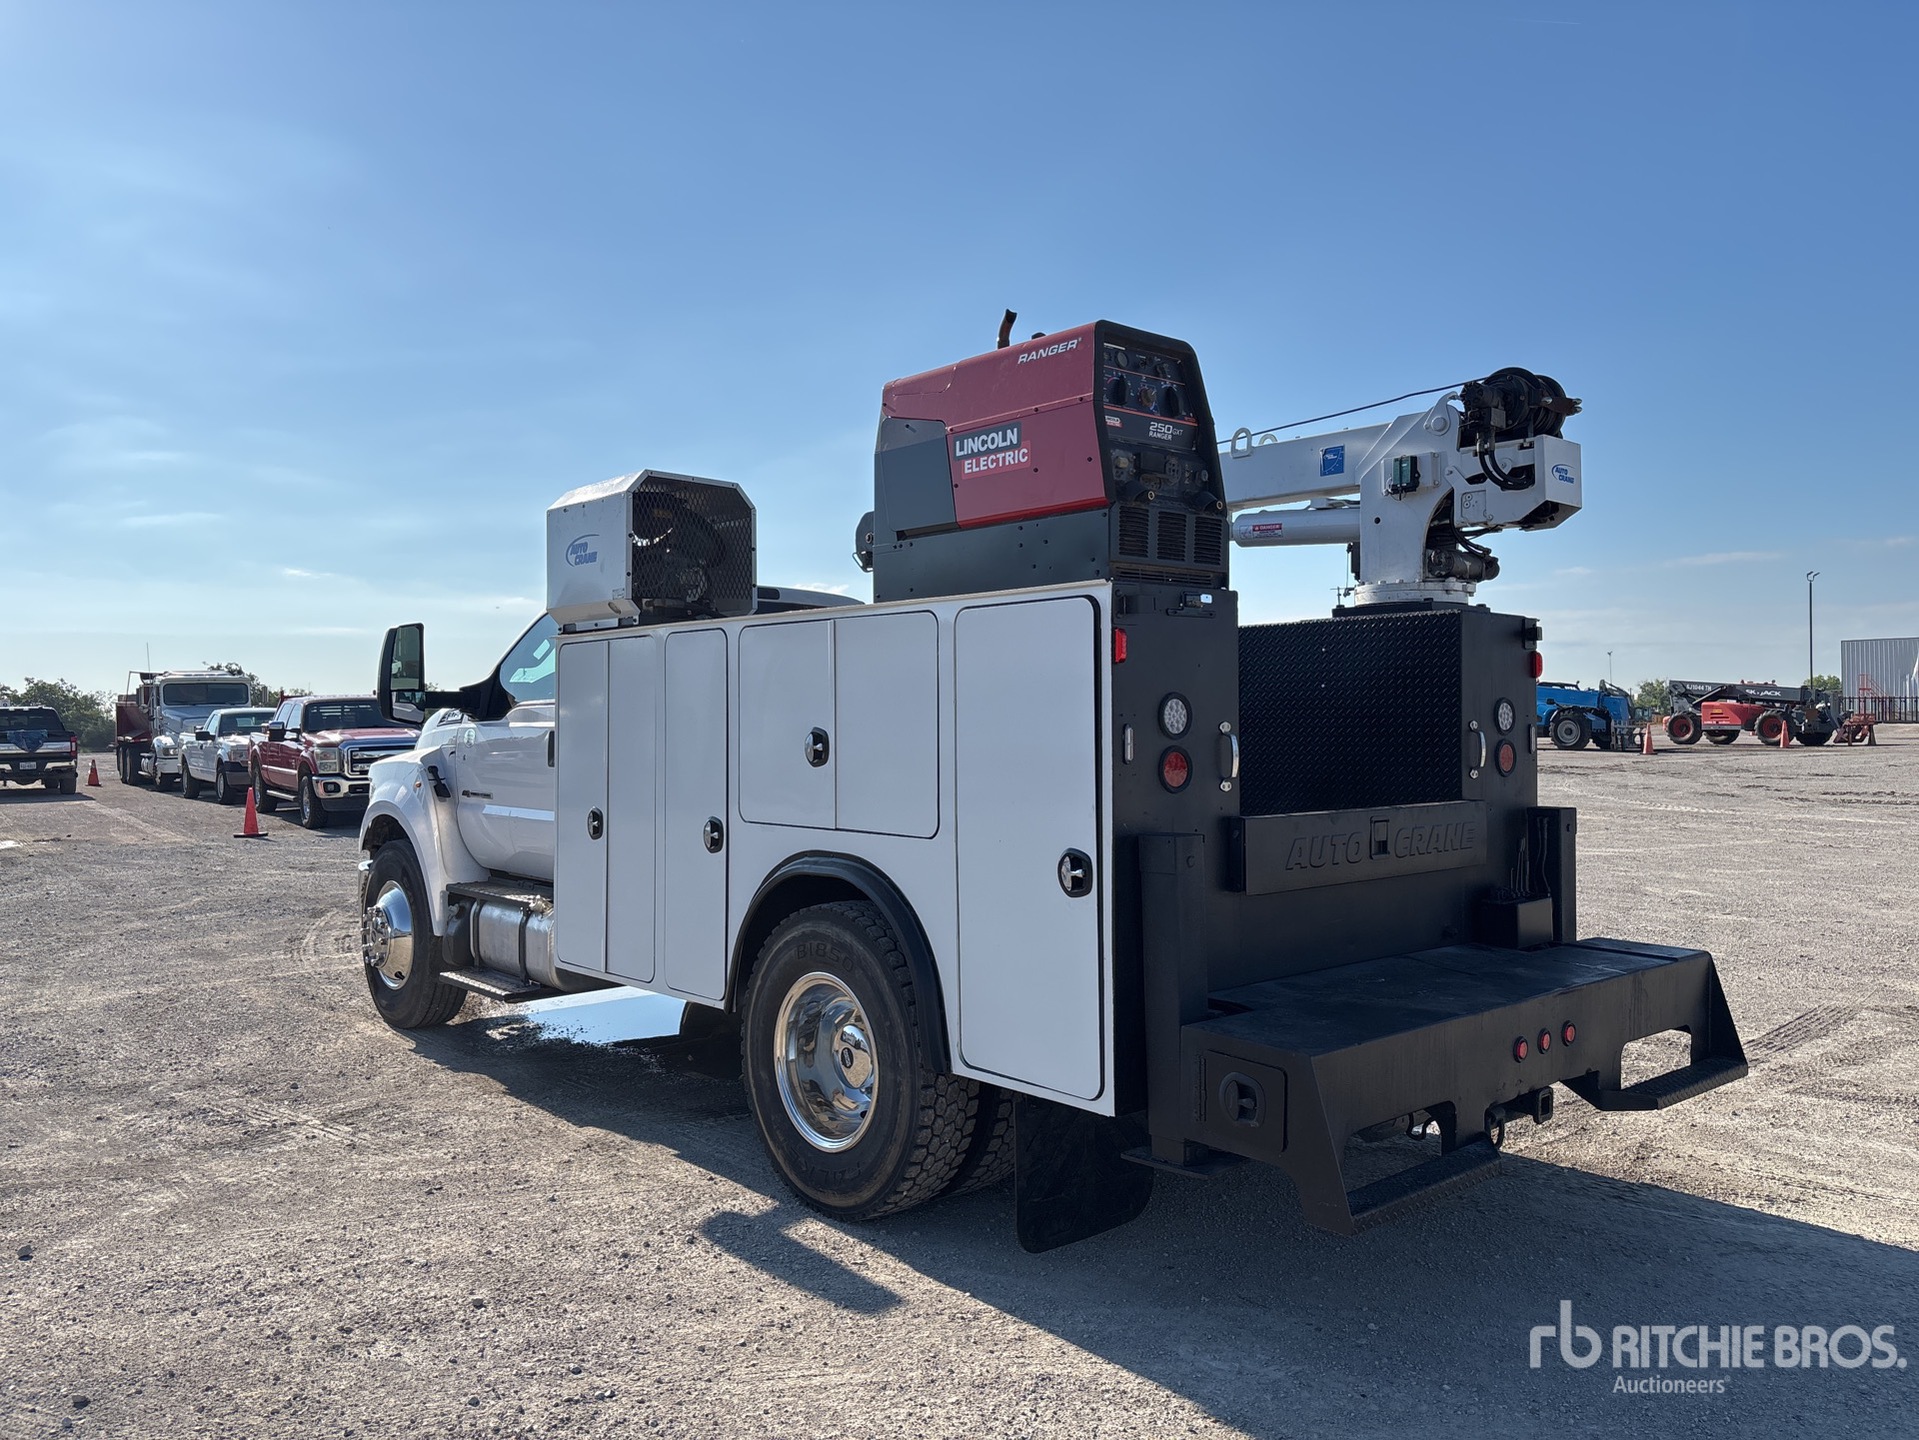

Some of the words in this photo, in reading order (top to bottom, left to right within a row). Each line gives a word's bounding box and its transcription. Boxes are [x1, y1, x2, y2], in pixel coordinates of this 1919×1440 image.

[1017, 337, 1081, 364] RANGER
[1149, 421, 1173, 434] 250
[955, 427, 1018, 457] LINCOLN
[1148, 431, 1173, 441] RANGER
[964, 448, 1029, 474] ELECTRIC
[1554, 466, 1569, 476] AUTO
[1558, 474, 1575, 485] CRANE
[569, 541, 589, 556] AUTO
[574, 551, 598, 566] CRANE
[1285, 831, 1363, 870] AUTO
[1394, 821, 1476, 858] CRANE
